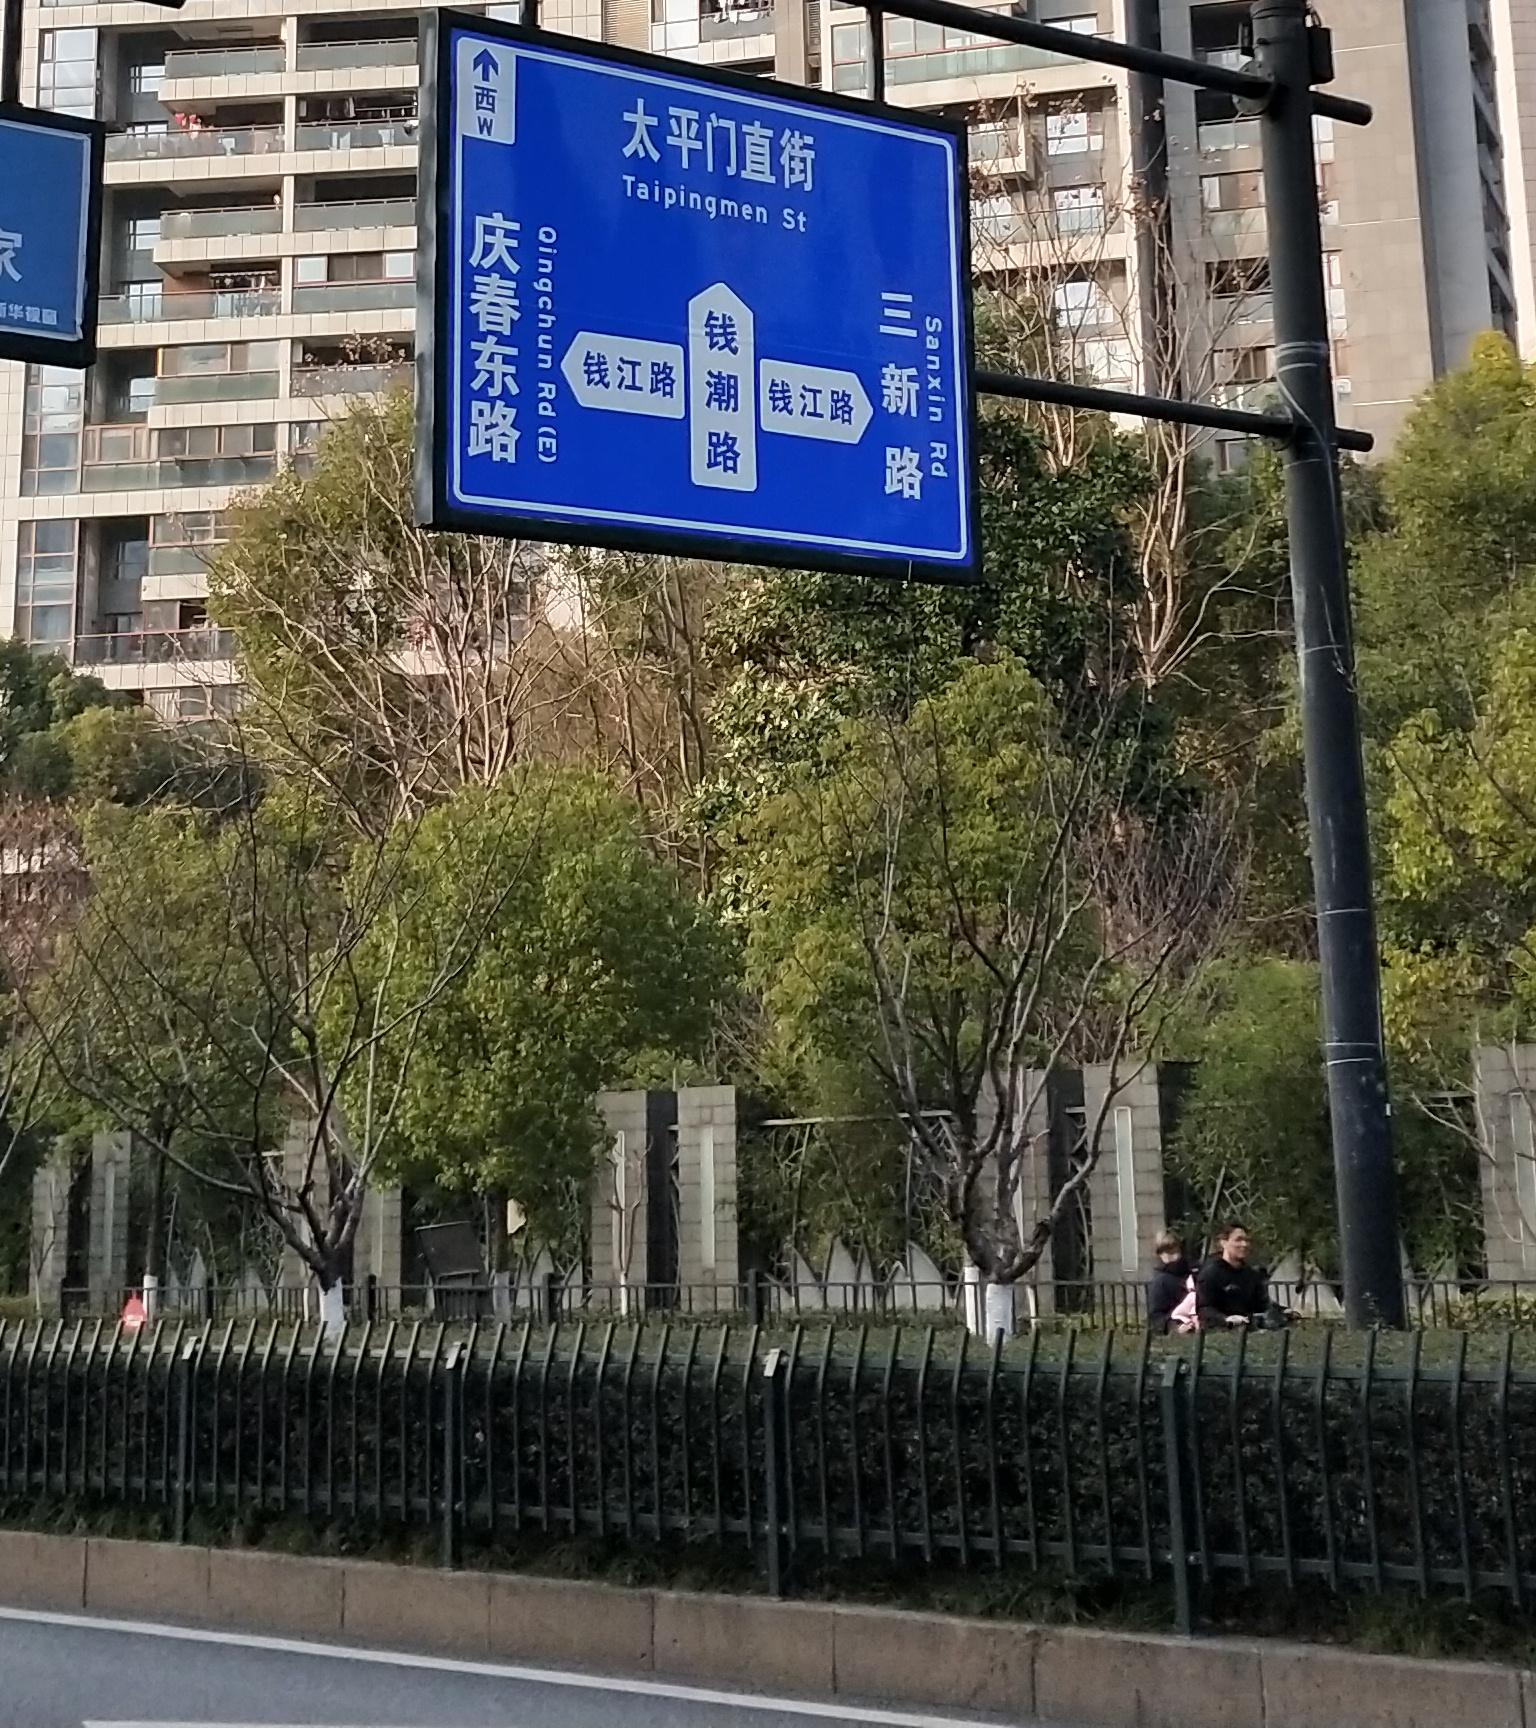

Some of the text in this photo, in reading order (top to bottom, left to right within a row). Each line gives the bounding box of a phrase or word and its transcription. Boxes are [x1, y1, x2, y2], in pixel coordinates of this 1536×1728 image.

[475, 85, 497, 113] 西
[477, 116, 493, 137] W
[622, 98, 816, 193] 太平门直街
[622, 174, 808, 233] Taipingmen St
[467, 212, 522, 464] 庆春东路
[533, 226, 558, 464] Qingchun Rd (E)
[582, 350, 677, 399] 钱江路
[703, 310, 741, 474] 钱潮路
[768, 377, 854, 426] 钱江路
[879, 291, 924, 500] 三新路
[924, 314, 948, 478] Sanxin Rd
